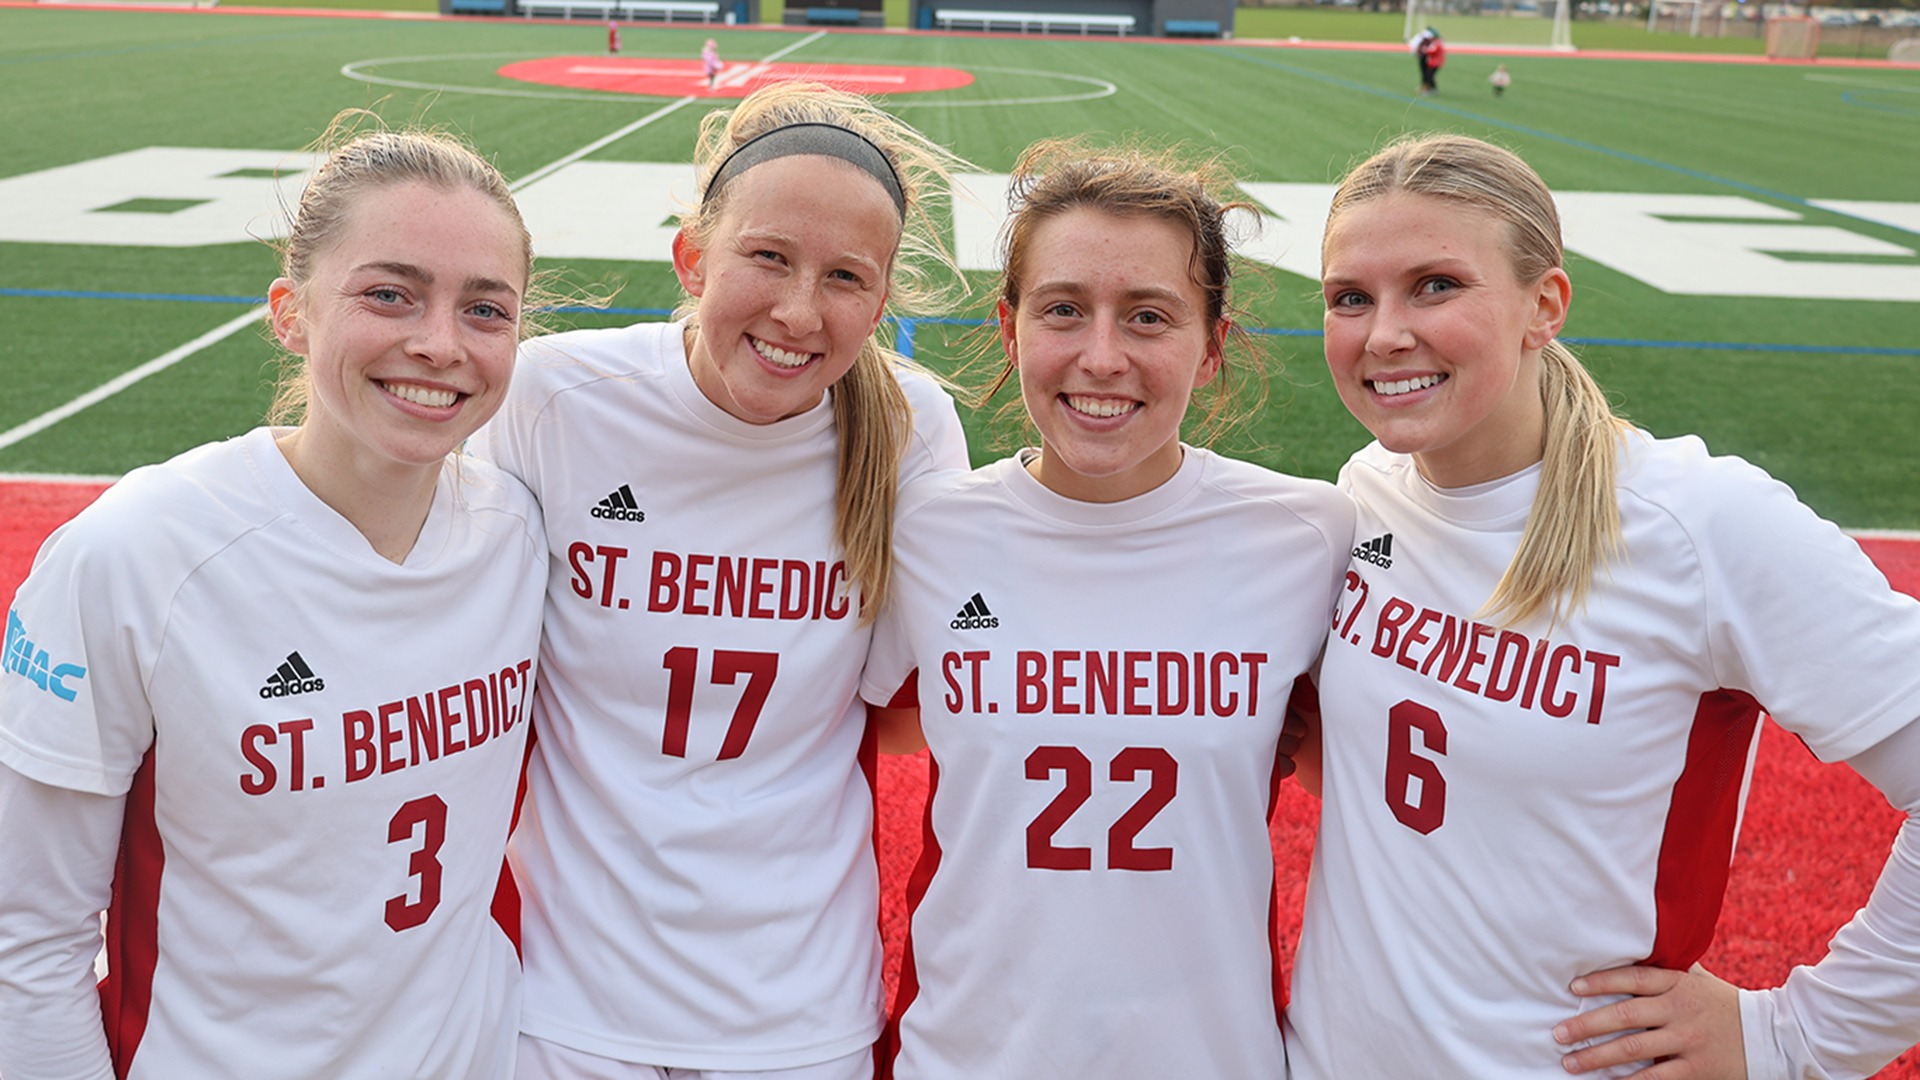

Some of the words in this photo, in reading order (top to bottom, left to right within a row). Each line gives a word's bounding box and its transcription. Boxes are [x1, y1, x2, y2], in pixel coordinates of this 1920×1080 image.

[590, 505, 645, 523] adidas
[1351, 545, 1393, 570] adidas
[568, 542, 630, 609] ST.
[647, 551, 867, 620] BENEDIC
[950, 614, 999, 630] adidas
[259, 675, 325, 699] adidas
[662, 646, 779, 761] 17
[942, 650, 998, 714] ST.
[1016, 650, 1268, 717] BENEDICT
[1371, 596, 1620, 725] BENEDICT
[240, 718, 325, 796] ST.
[342, 659, 531, 784] BENEDICT
[1385, 699, 1448, 836] 6
[1024, 746, 1178, 871] 22
[384, 793, 448, 933] 3
